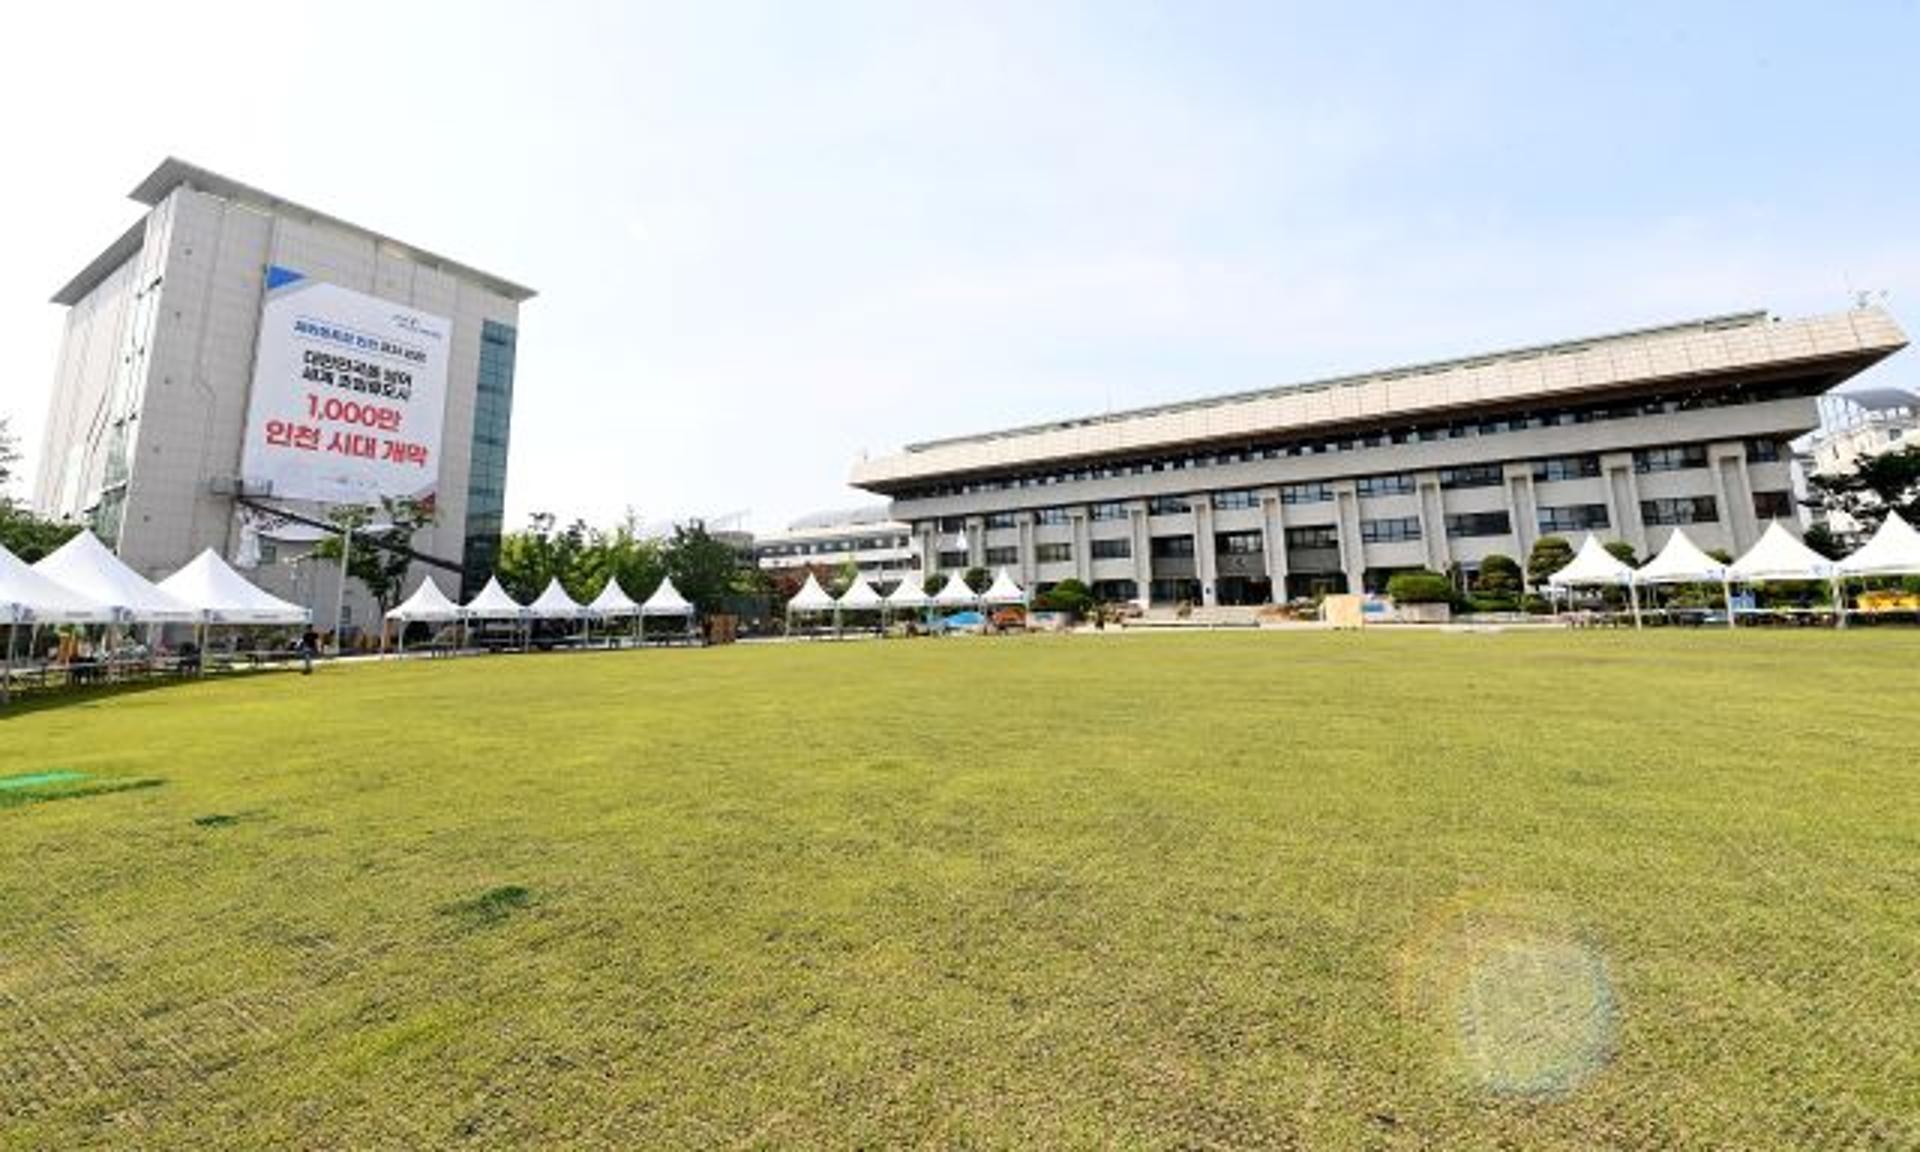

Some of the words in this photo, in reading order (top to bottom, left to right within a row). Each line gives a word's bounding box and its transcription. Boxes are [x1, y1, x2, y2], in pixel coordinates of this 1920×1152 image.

[308, 393, 402, 432] 1,000만
[266, 420, 320, 450] 인천
[327, 432, 376, 459] 시대
[381, 440, 428, 467] 개막
